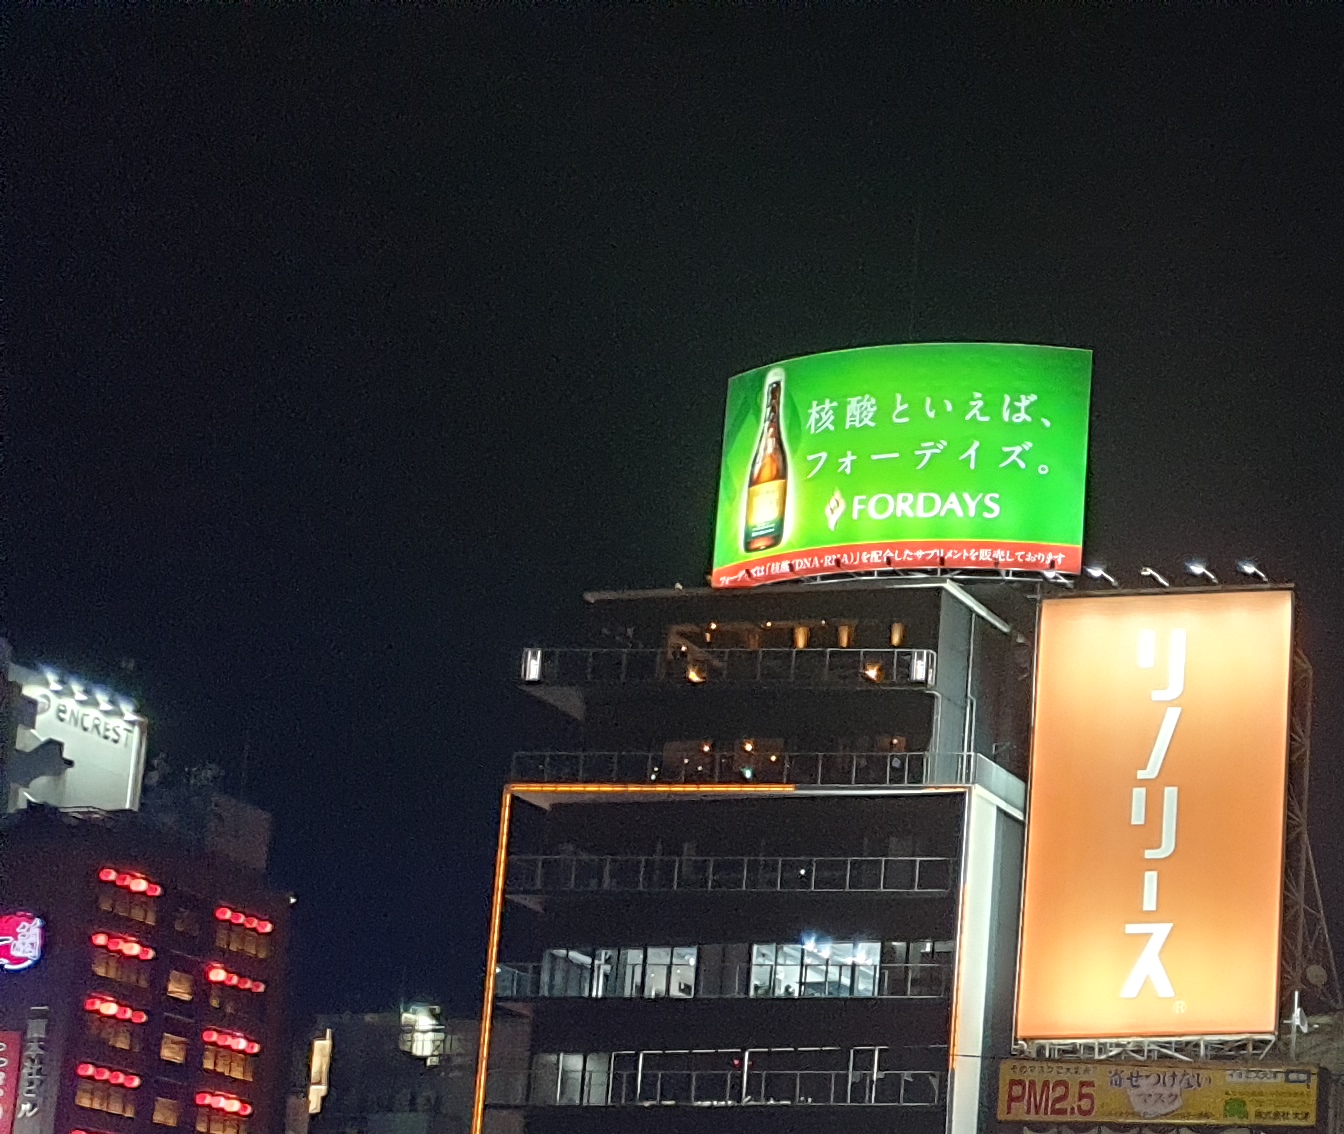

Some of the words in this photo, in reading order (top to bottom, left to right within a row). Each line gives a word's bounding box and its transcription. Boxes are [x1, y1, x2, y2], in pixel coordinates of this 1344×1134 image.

[806, 391, 1051, 435] 核酸といえば、
[805, 439, 1050, 480] フォーデイズ。
[851, 491, 1001, 521] FORDAYS
[1119, 627, 1188, 999] リノリース
[1006, 1078, 1096, 1117] PM2.5
[1108, 1068, 1213, 1090] 寄せつけない
